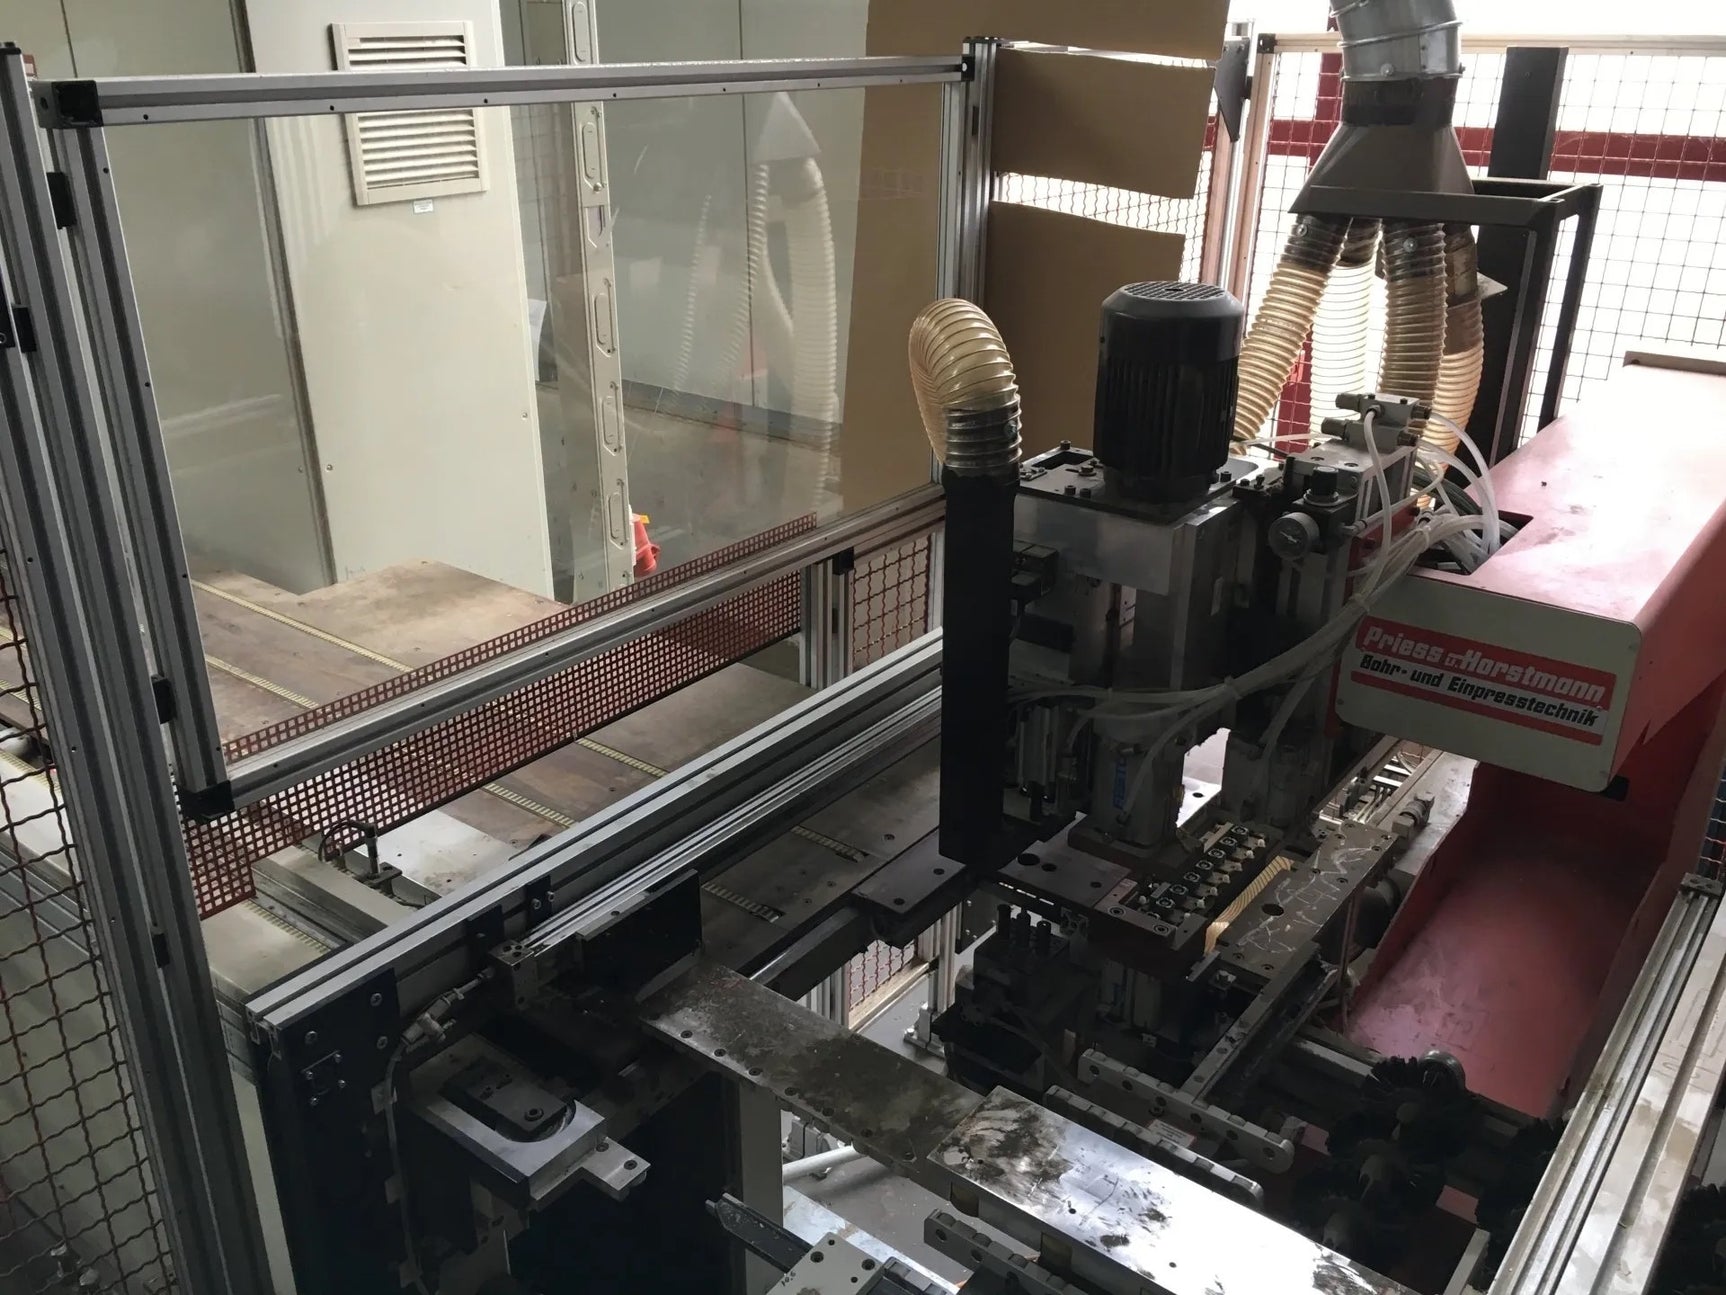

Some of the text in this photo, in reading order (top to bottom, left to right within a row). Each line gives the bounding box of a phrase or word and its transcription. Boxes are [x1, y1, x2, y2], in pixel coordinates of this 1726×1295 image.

[1360, 653, 1599, 727] Bohr- und Einpresstechnik
[1363, 626, 1444, 663] Priess
[1459, 648, 1605, 702] Horstmann
